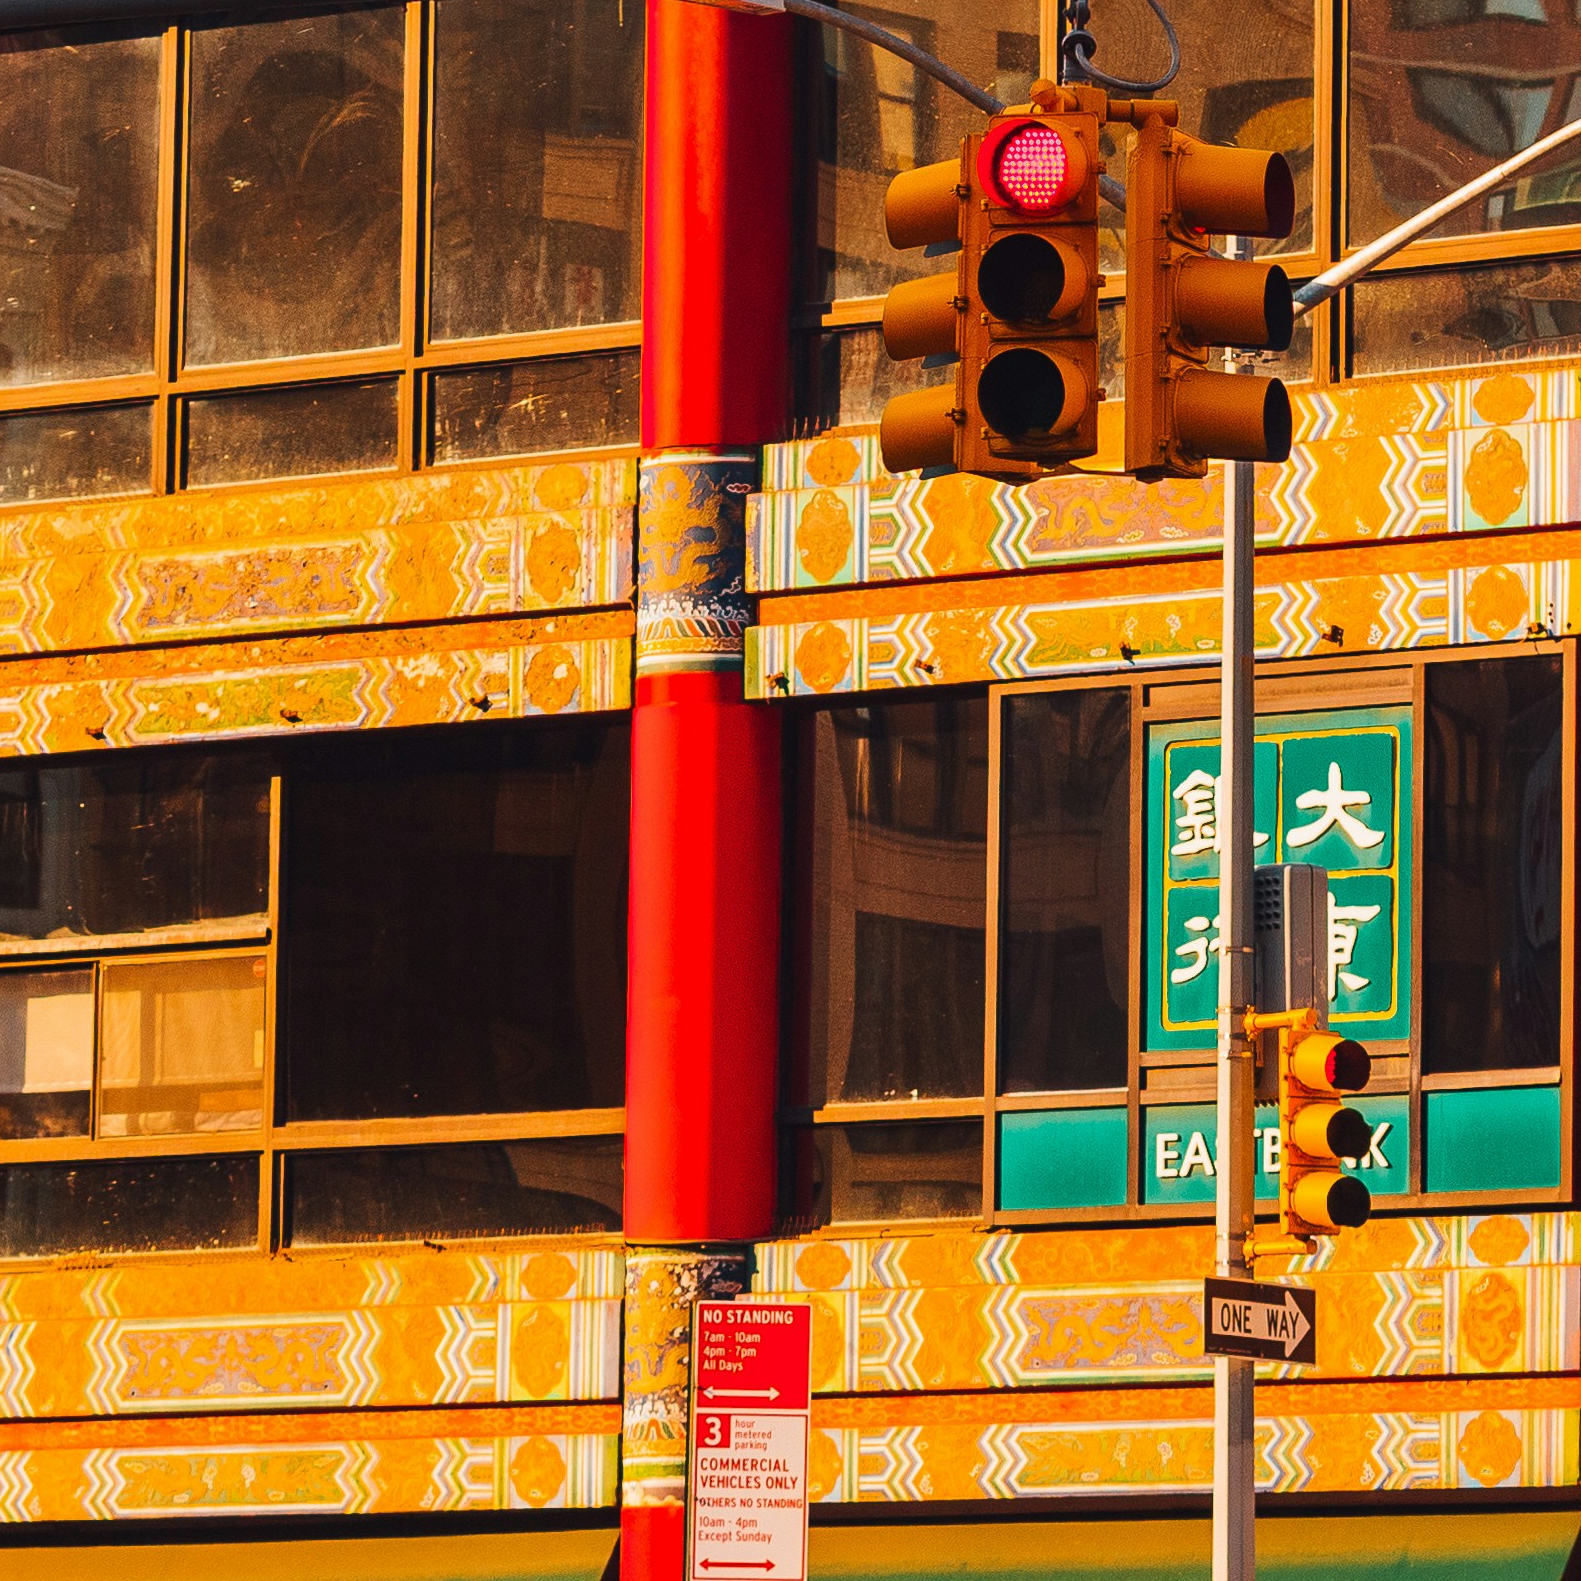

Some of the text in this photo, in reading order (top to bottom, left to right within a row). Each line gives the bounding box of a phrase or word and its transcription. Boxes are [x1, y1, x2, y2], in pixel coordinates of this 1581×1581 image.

[703, 1310, 794, 1325] NO STANDING
[1221, 1303, 1300, 1340] ONE WAY
[704, 1331, 725, 1343] 7am
[735, 1331, 761, 1343] 10am
[703, 1346, 726, 1358] 4pm
[735, 1346, 757, 1359] 7pm
[703, 1360, 744, 1373] All Days
[735, 1419, 756, 1429] hour
[704, 1416, 722, 1446] 3
[735, 1430, 772, 1440] metered
[735, 1440, 768, 1451] parking
[700, 1457, 790, 1472] COMMERCIAL
[700, 1475, 798, 1490] VEHICLES ONLY
[699, 1497, 803, 1509] OTHERS NO STANDING
[699, 1516, 725, 1527] 10am
[736, 1517, 758, 1530] 4pm
[698, 1530, 772, 1544] Except Sunday
